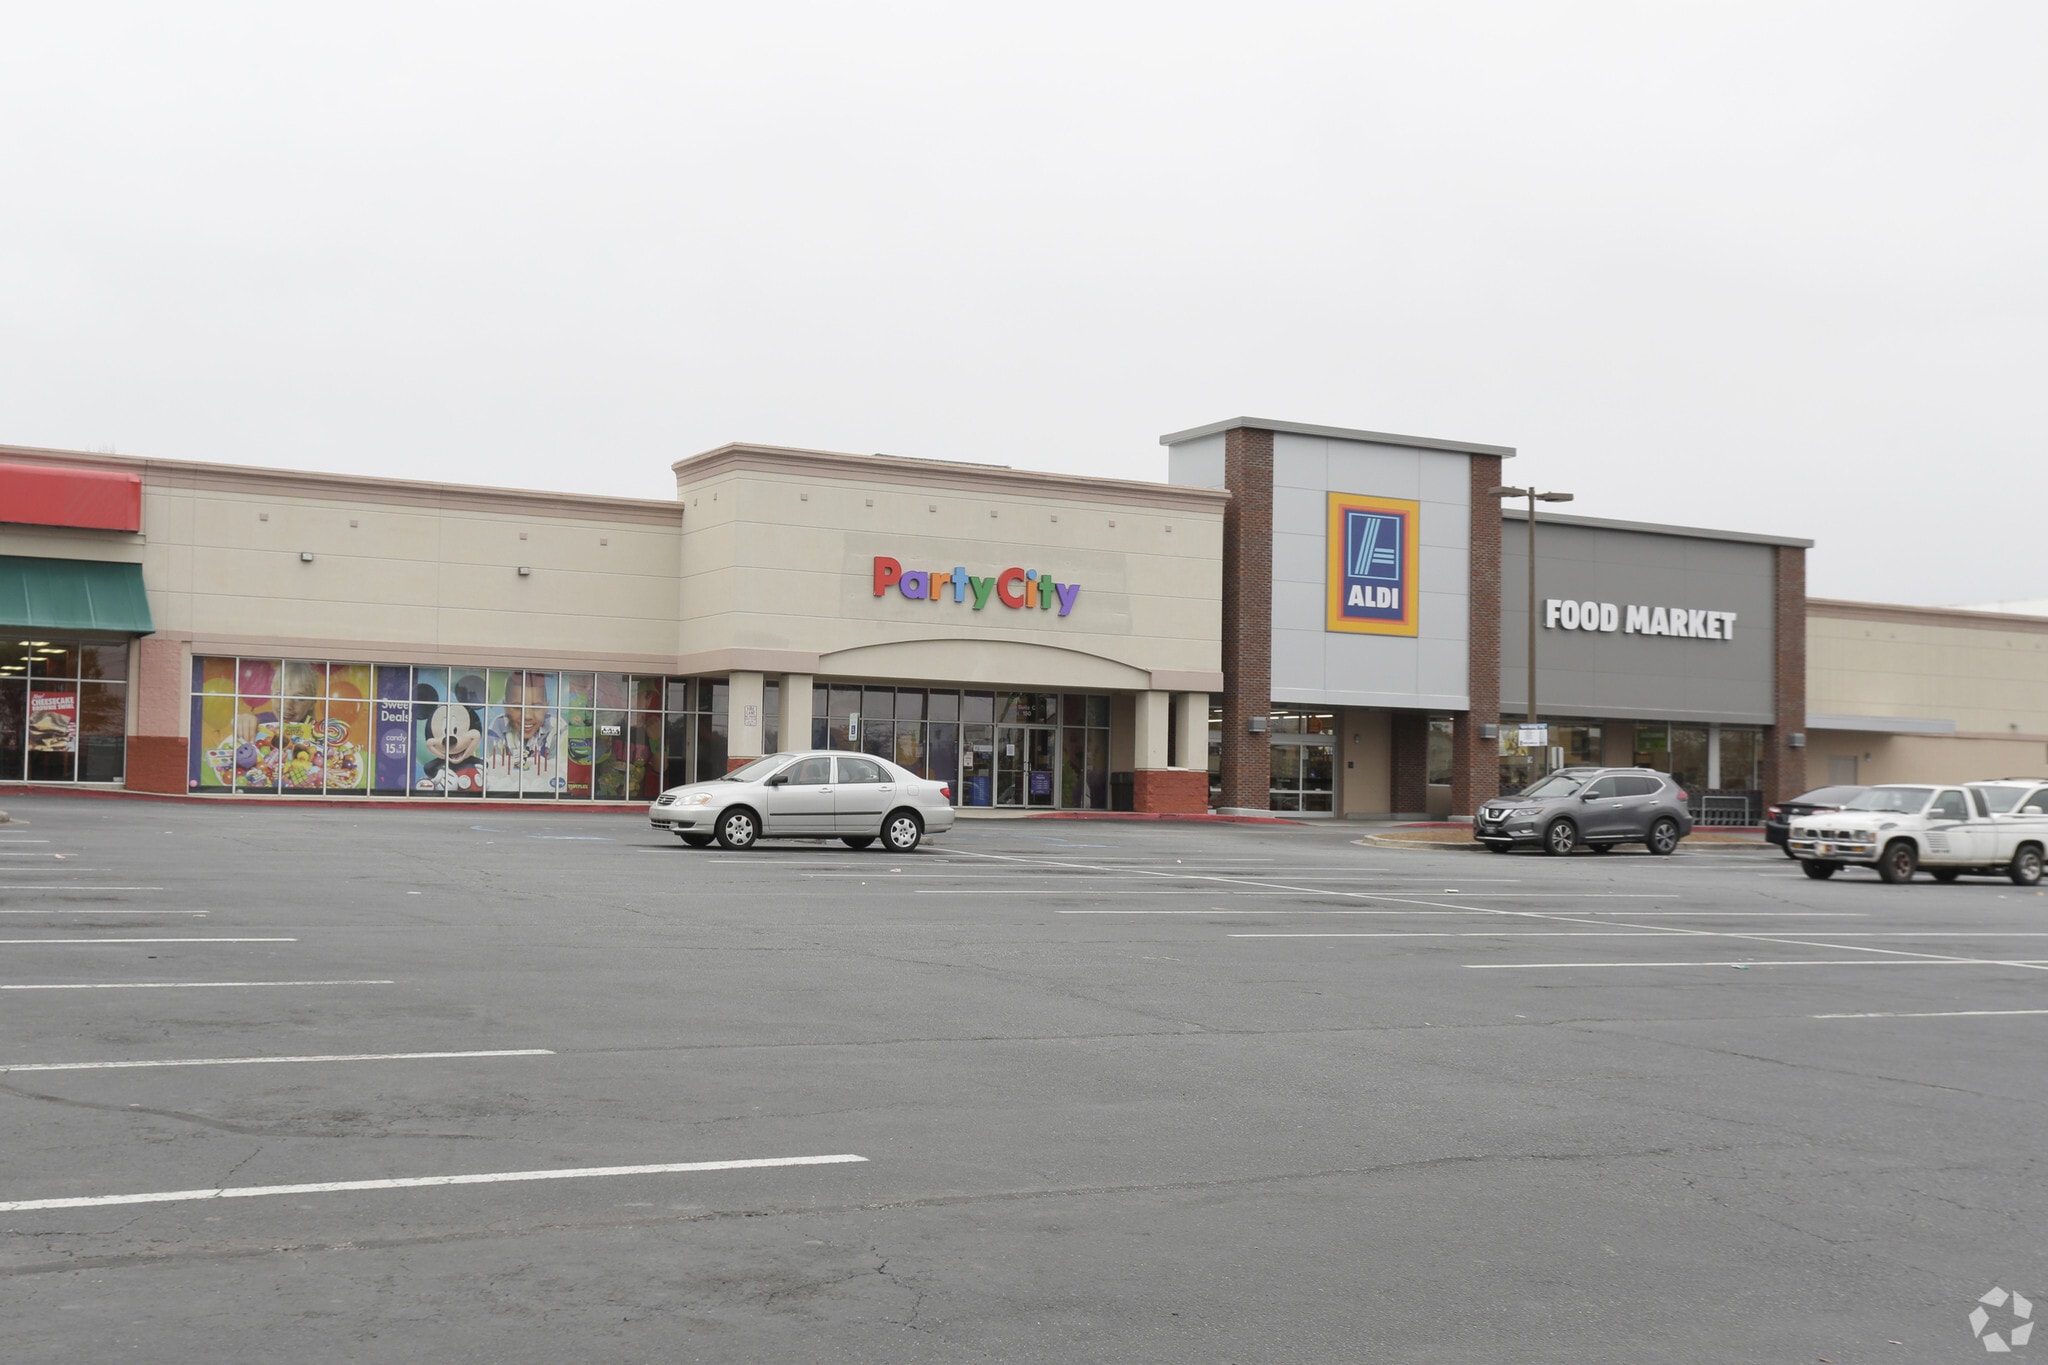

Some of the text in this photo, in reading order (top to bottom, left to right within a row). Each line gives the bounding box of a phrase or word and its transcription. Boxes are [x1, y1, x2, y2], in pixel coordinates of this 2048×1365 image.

[1347, 584, 1399, 610] ALDI
[1546, 599, 1736, 640] FOOD MARKET
[32, 697, 75, 705] CHEESECAKE
[381, 698, 410, 709] Swee
[386, 733, 407, 743] candy
[385, 743, 396, 754] 15
